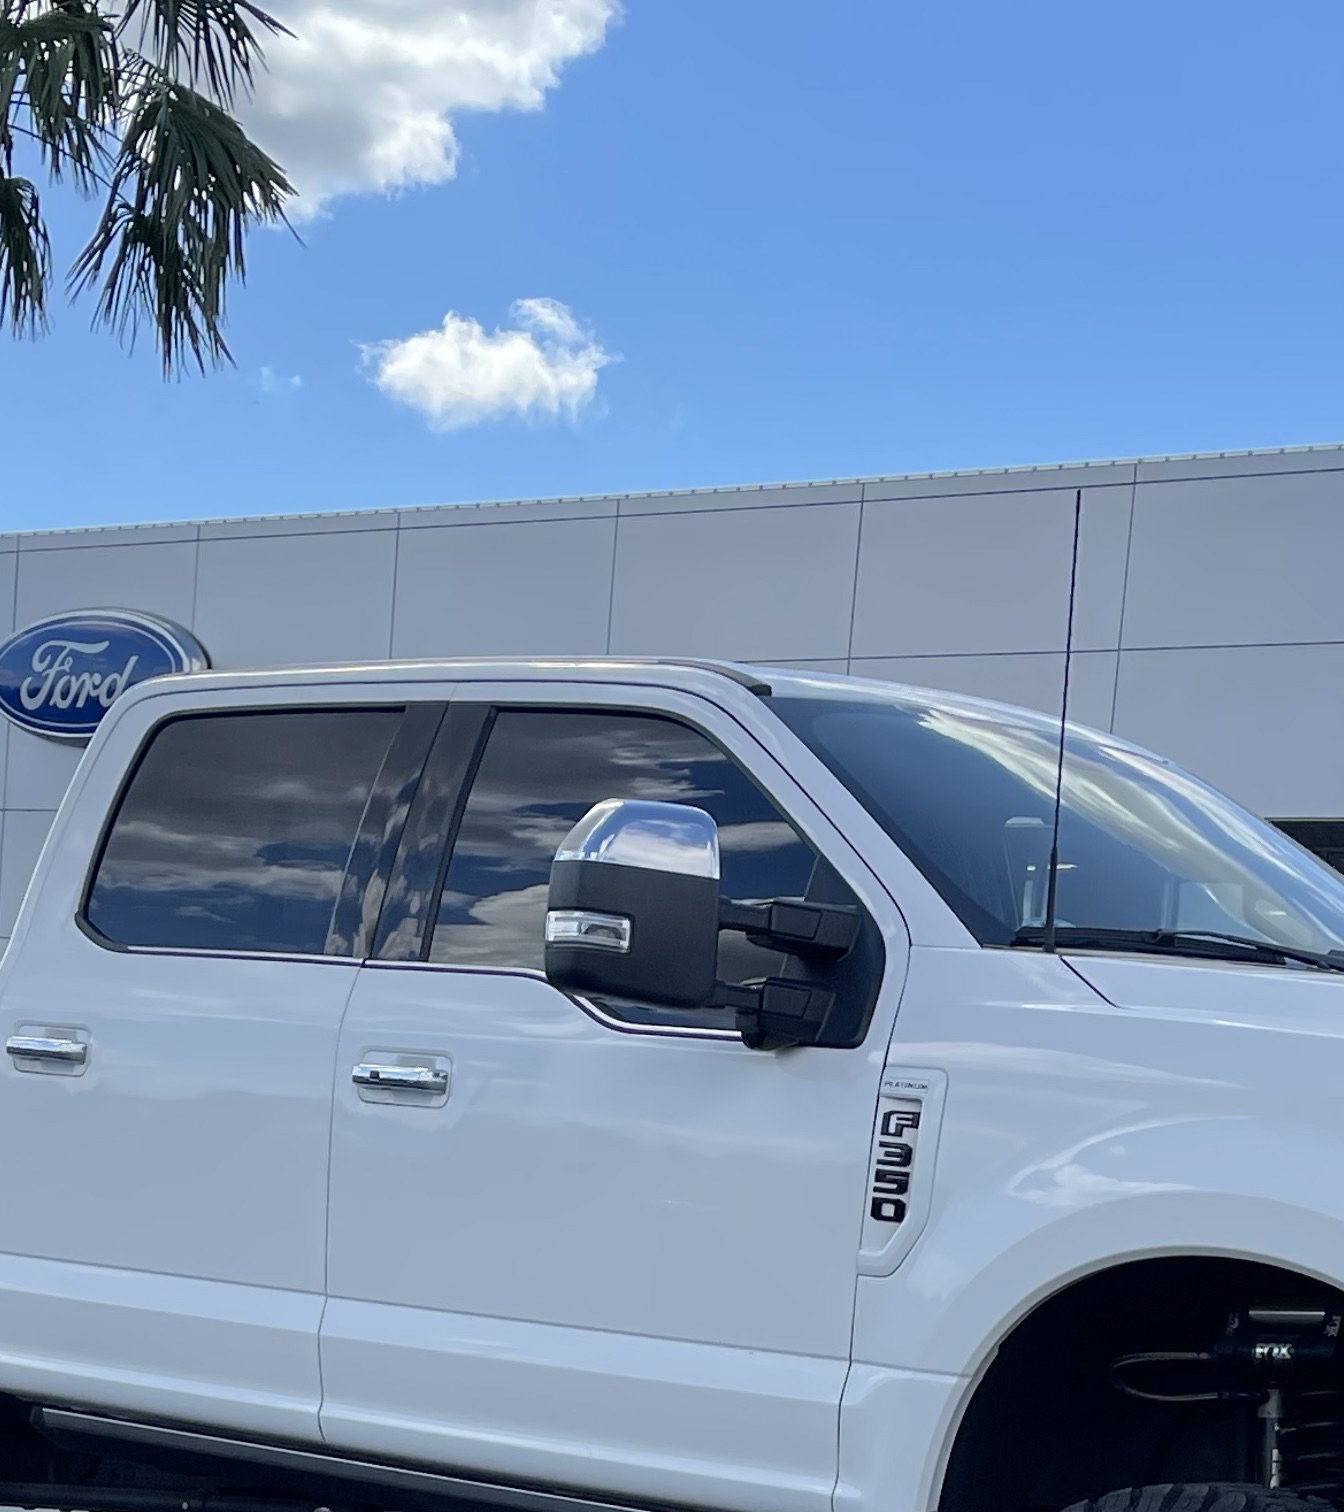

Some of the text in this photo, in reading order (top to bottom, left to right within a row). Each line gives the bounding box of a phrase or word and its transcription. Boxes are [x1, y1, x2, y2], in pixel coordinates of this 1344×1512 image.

[19, 638, 140, 711] Ford
[870, 1110, 921, 1224] F350
[1252, 1342, 1294, 1360] FOX
